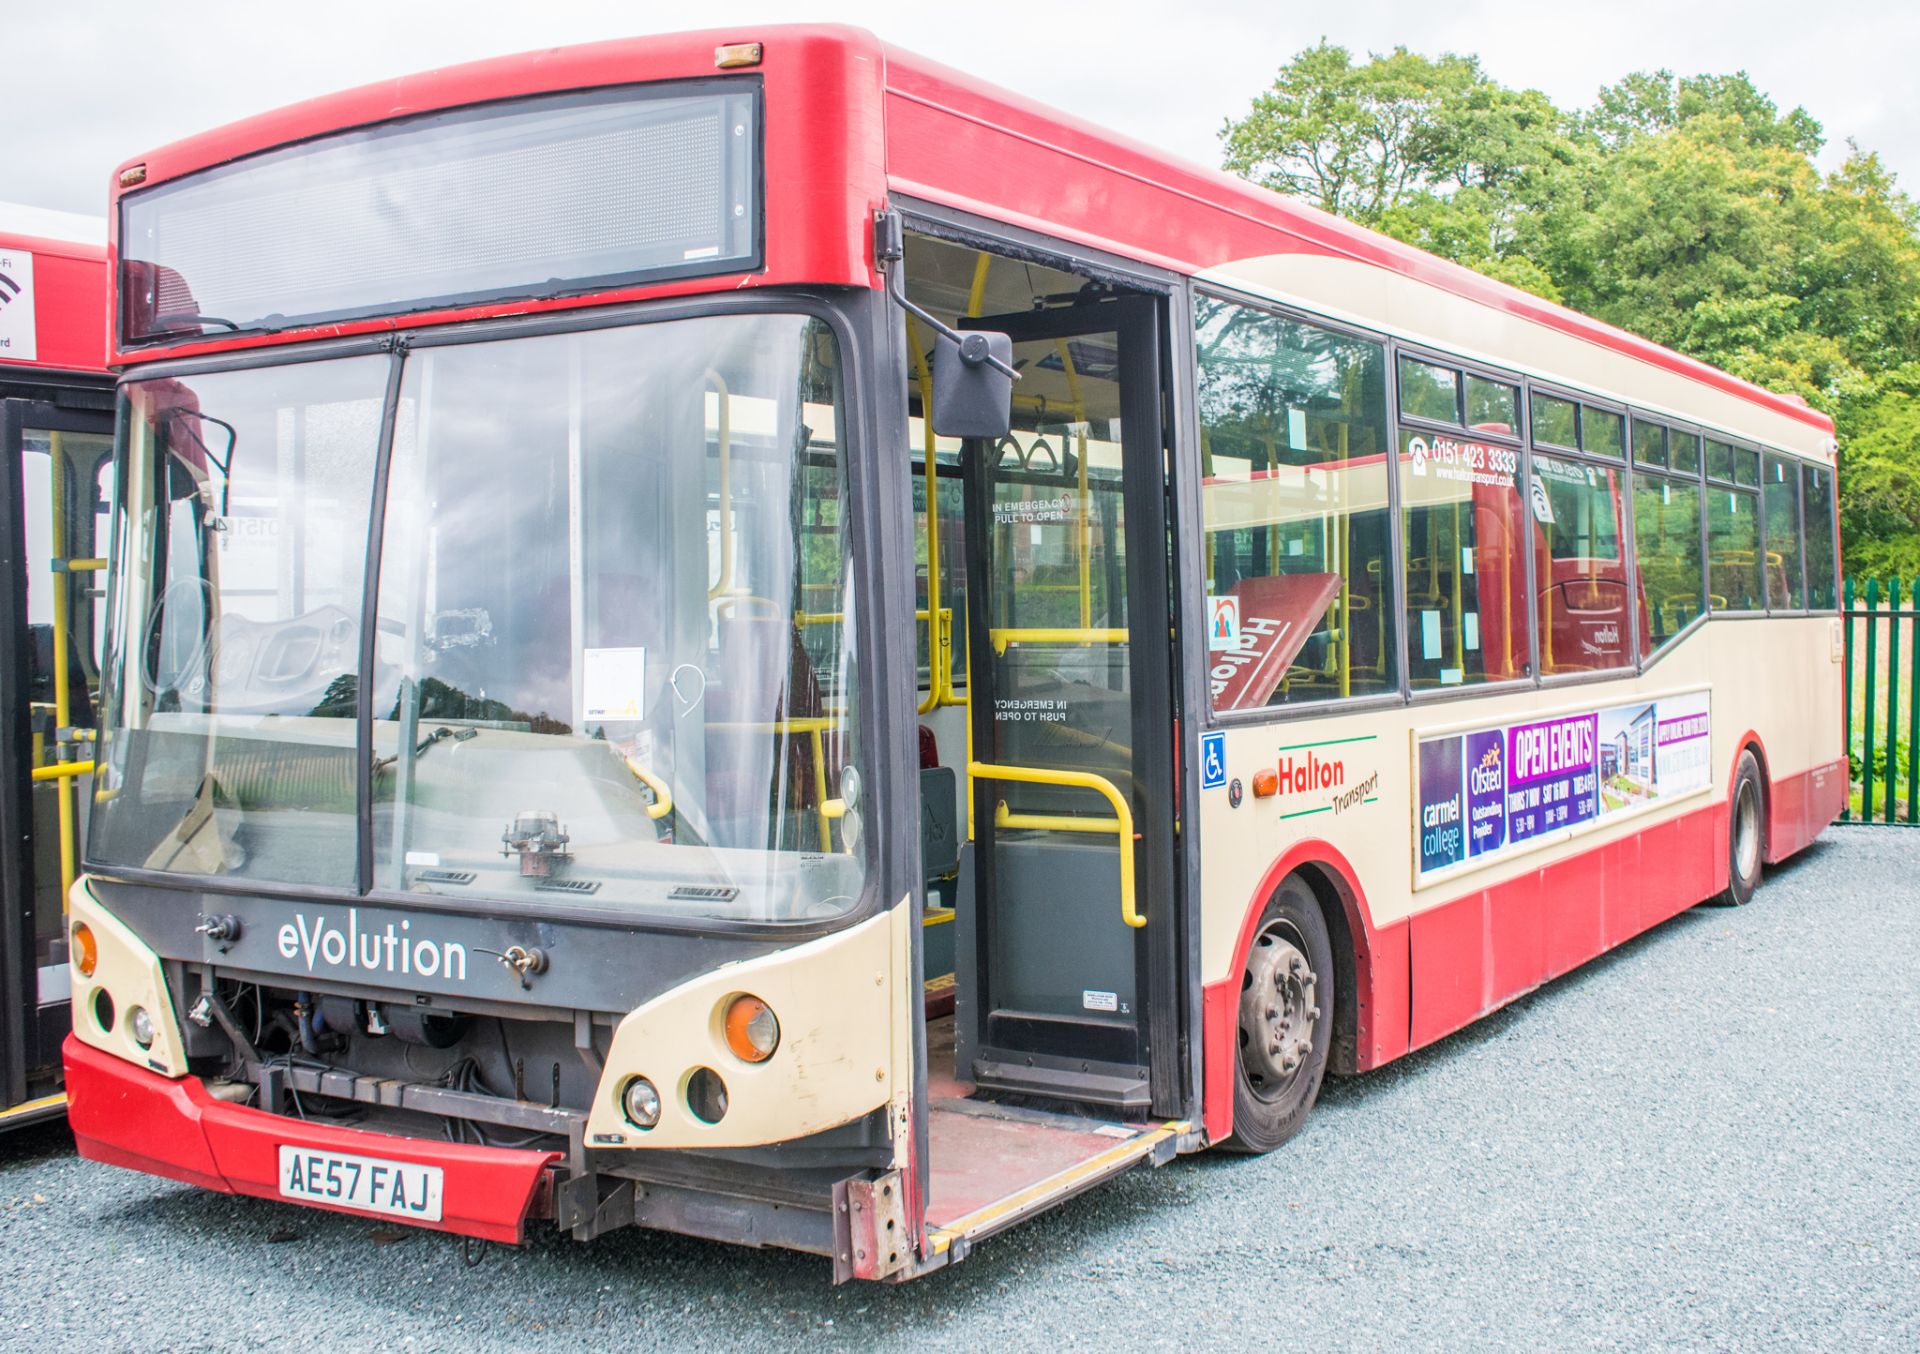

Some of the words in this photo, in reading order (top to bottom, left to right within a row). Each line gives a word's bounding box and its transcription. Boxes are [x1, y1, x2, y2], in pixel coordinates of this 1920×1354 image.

[1432, 438, 1459, 465] 0151
[1462, 446, 1485, 469] 423
[1488, 448, 1516, 474] 3333
[992, 503, 1002, 513] IN
[1004, 498, 1065, 512] EMERGENCY
[994, 513, 1019, 524] PULL
[1021, 512, 1034, 523] TO
[1036, 511, 1064, 522] OPEN
[1516, 726, 1549, 779] OPEN
[1550, 719, 1593, 772] EVENTS
[1279, 750, 1344, 795] Halton
[1471, 760, 1502, 796] Ofsted
[1332, 770, 1378, 816] Transport
[1423, 792, 1460, 828] carmel
[1472, 801, 1503, 822] Outstanding
[1424, 826, 1460, 856] college
[277, 907, 466, 980] eVolution
[289, 1154, 362, 1200] AE57
[370, 1166, 428, 1212] FAJ
